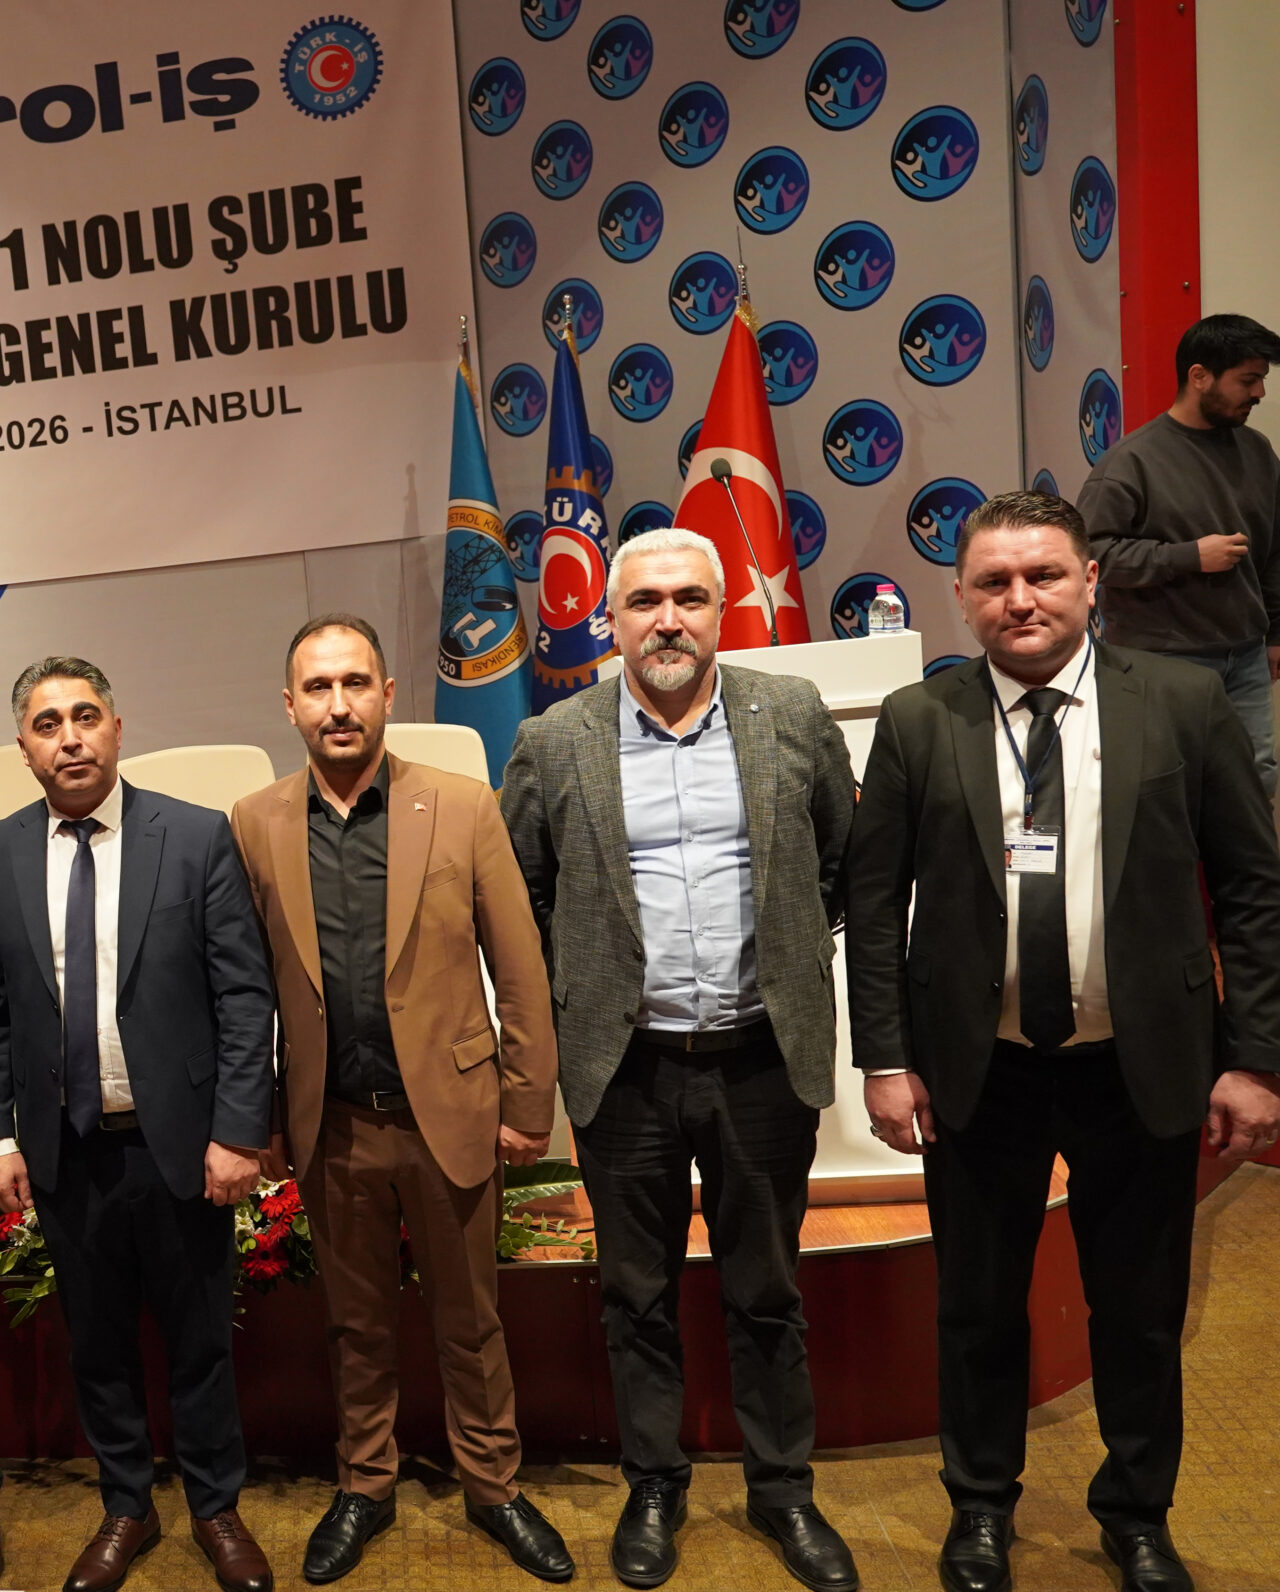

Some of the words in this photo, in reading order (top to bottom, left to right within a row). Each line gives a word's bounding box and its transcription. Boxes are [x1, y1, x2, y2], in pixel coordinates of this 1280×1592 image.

[314, 86, 358, 105] 1952
[41, 202, 194, 286] NOLU
[207, 175, 368, 275] ŞUBE
[169, 266, 408, 362] KURULU
[104, 385, 302, 438] İSTANBUL
[439, 655, 456, 676] 950
